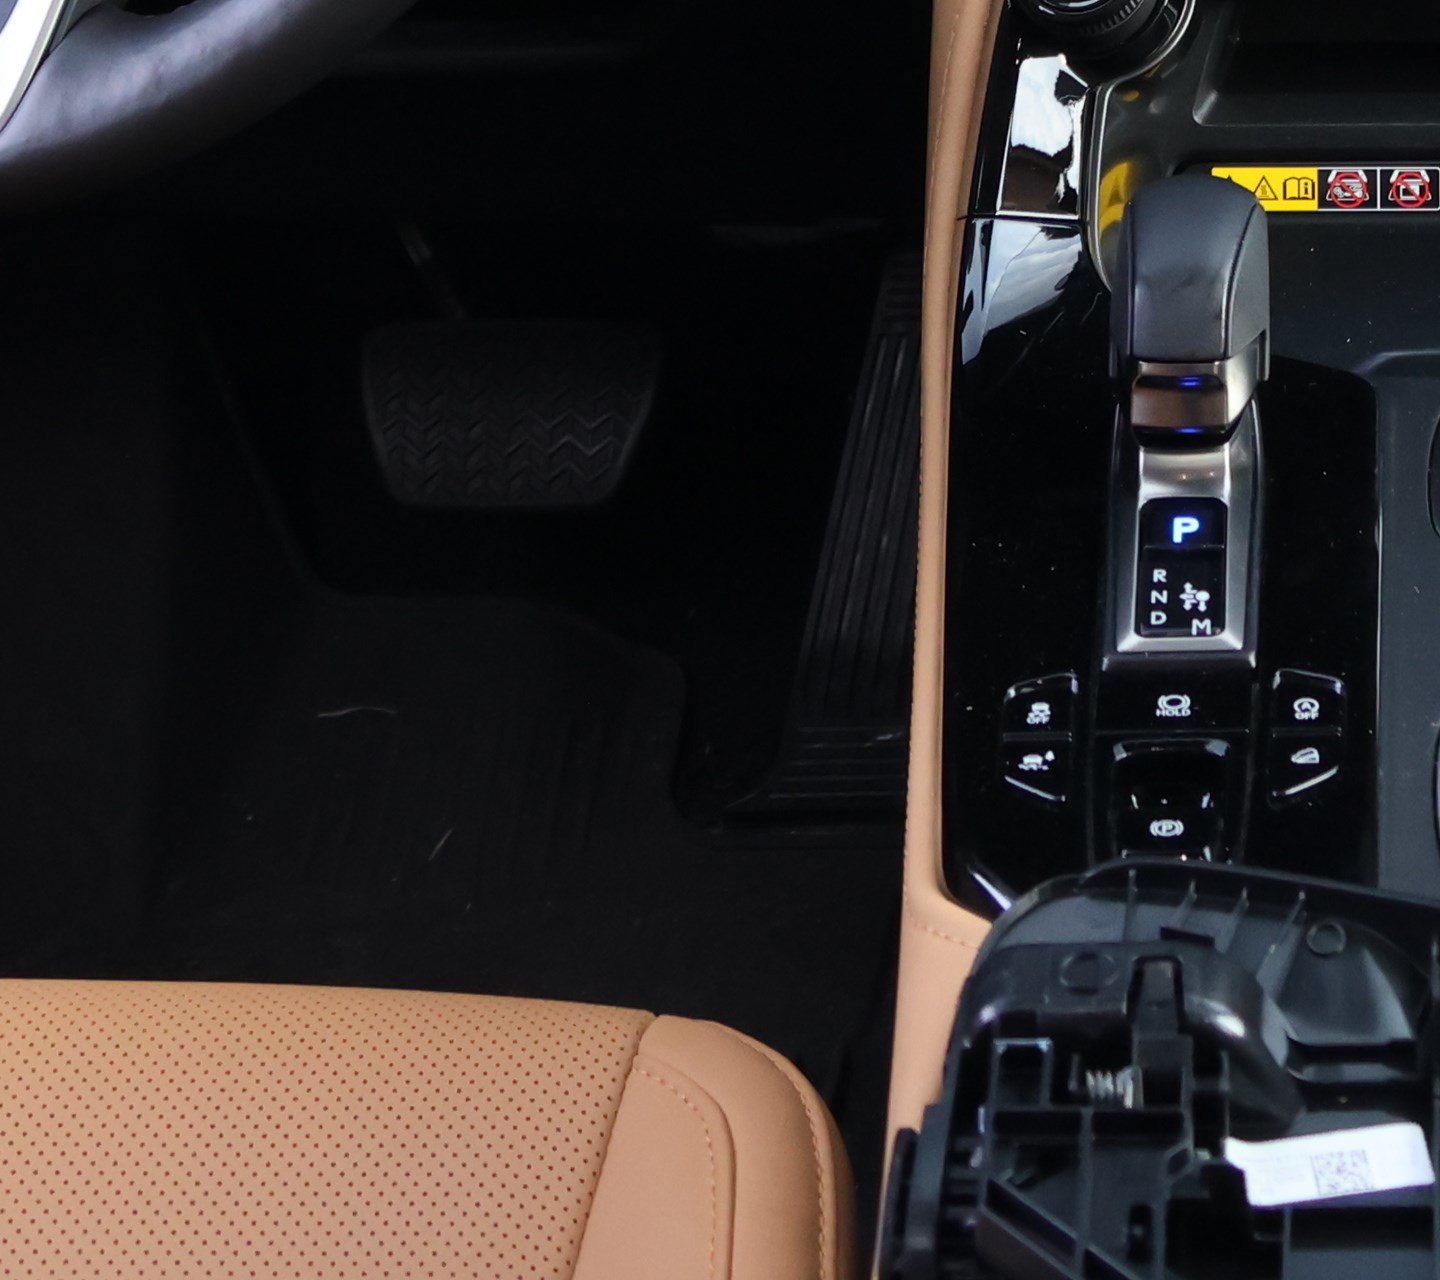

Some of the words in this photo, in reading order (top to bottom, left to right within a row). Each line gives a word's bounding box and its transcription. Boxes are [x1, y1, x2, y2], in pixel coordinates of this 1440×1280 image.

[1171, 515, 1201, 544] P
[1152, 568, 1168, 583] R
[1150, 590, 1169, 605] N
[1150, 610, 1168, 626] D
[1190, 618, 1213, 636] M
[1155, 708, 1192, 717] HOLD
[1293, 711, 1320, 721] OFF
[1026, 716, 1050, 725] OFF
